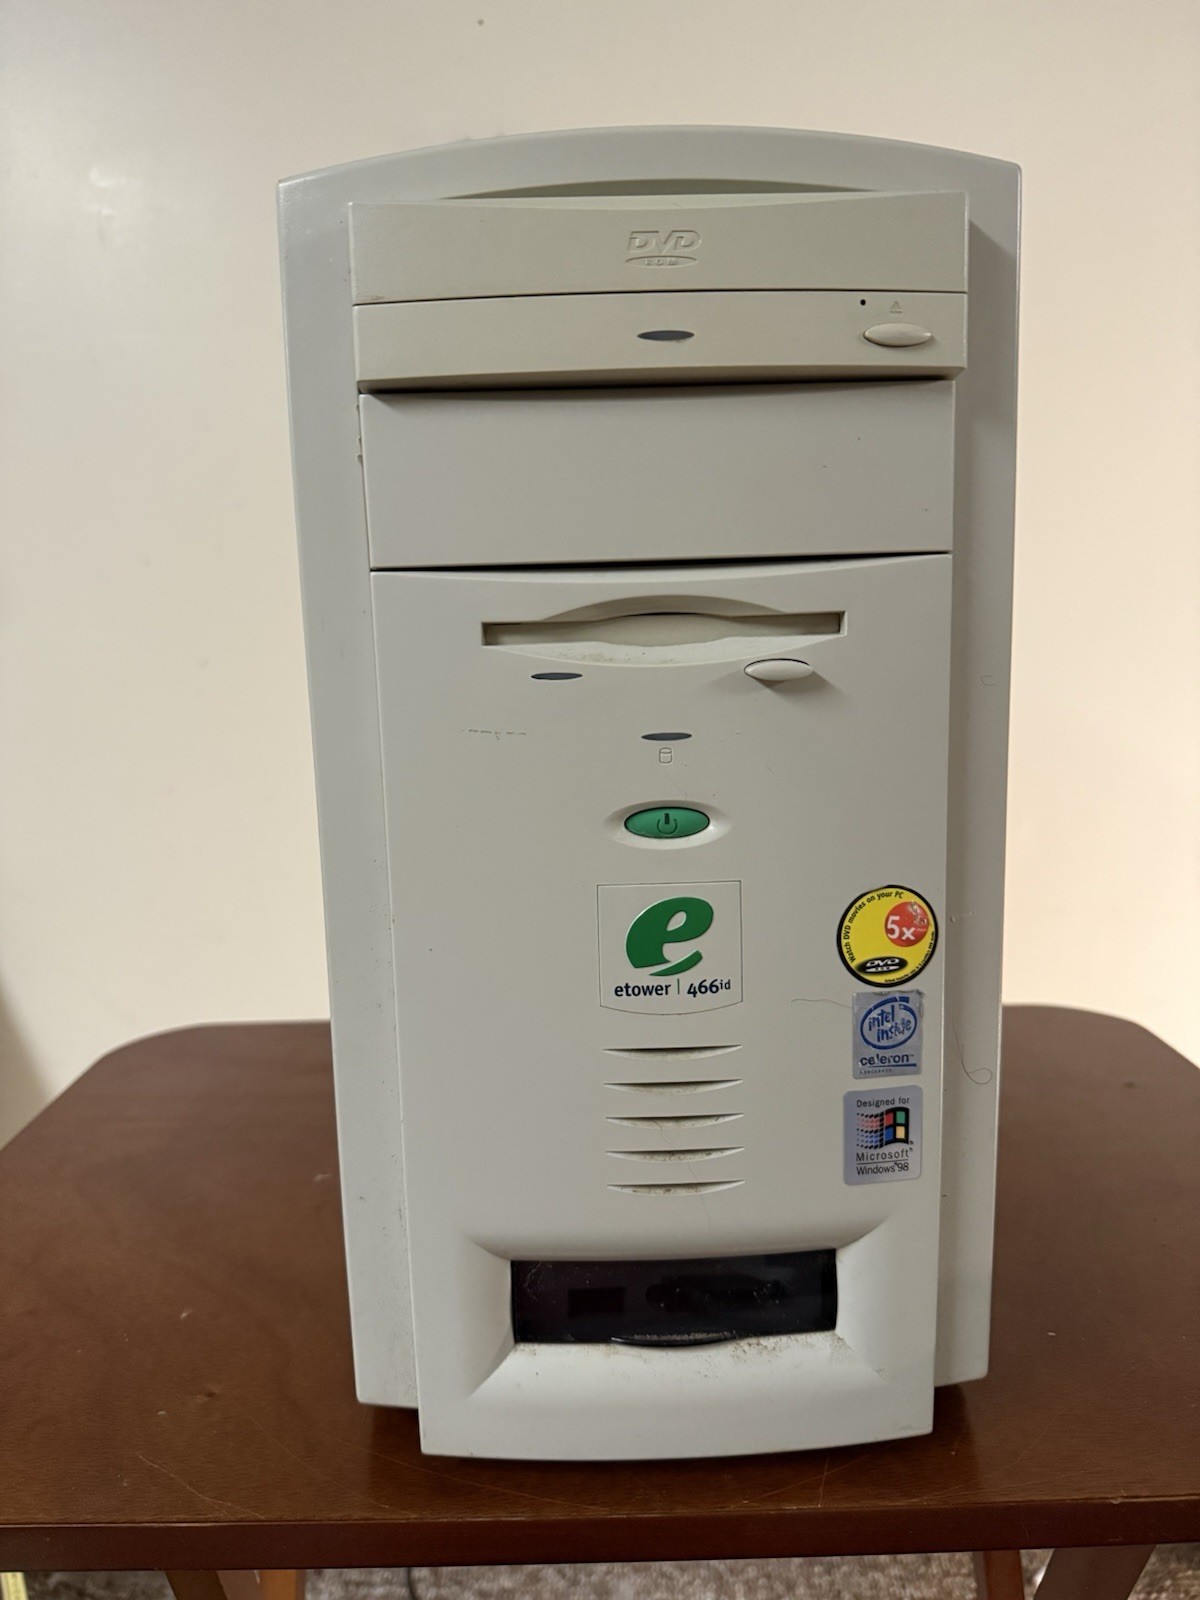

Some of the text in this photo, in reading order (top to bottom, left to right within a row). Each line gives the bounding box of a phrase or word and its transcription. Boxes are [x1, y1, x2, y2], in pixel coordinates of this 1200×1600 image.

[627, 230, 702, 254] DVD
[843, 891, 904, 963] Watch DVD movies on your PC
[887, 915, 915, 941] 5x
[866, 958, 899, 968] DVD
[614, 979, 731, 998] etower 466id
[868, 1005, 895, 1032] intel
[856, 1097, 910, 1108] Designed for
[856, 1149, 909, 1161] Microsoft
[856, 1165, 895, 1176] Windows
